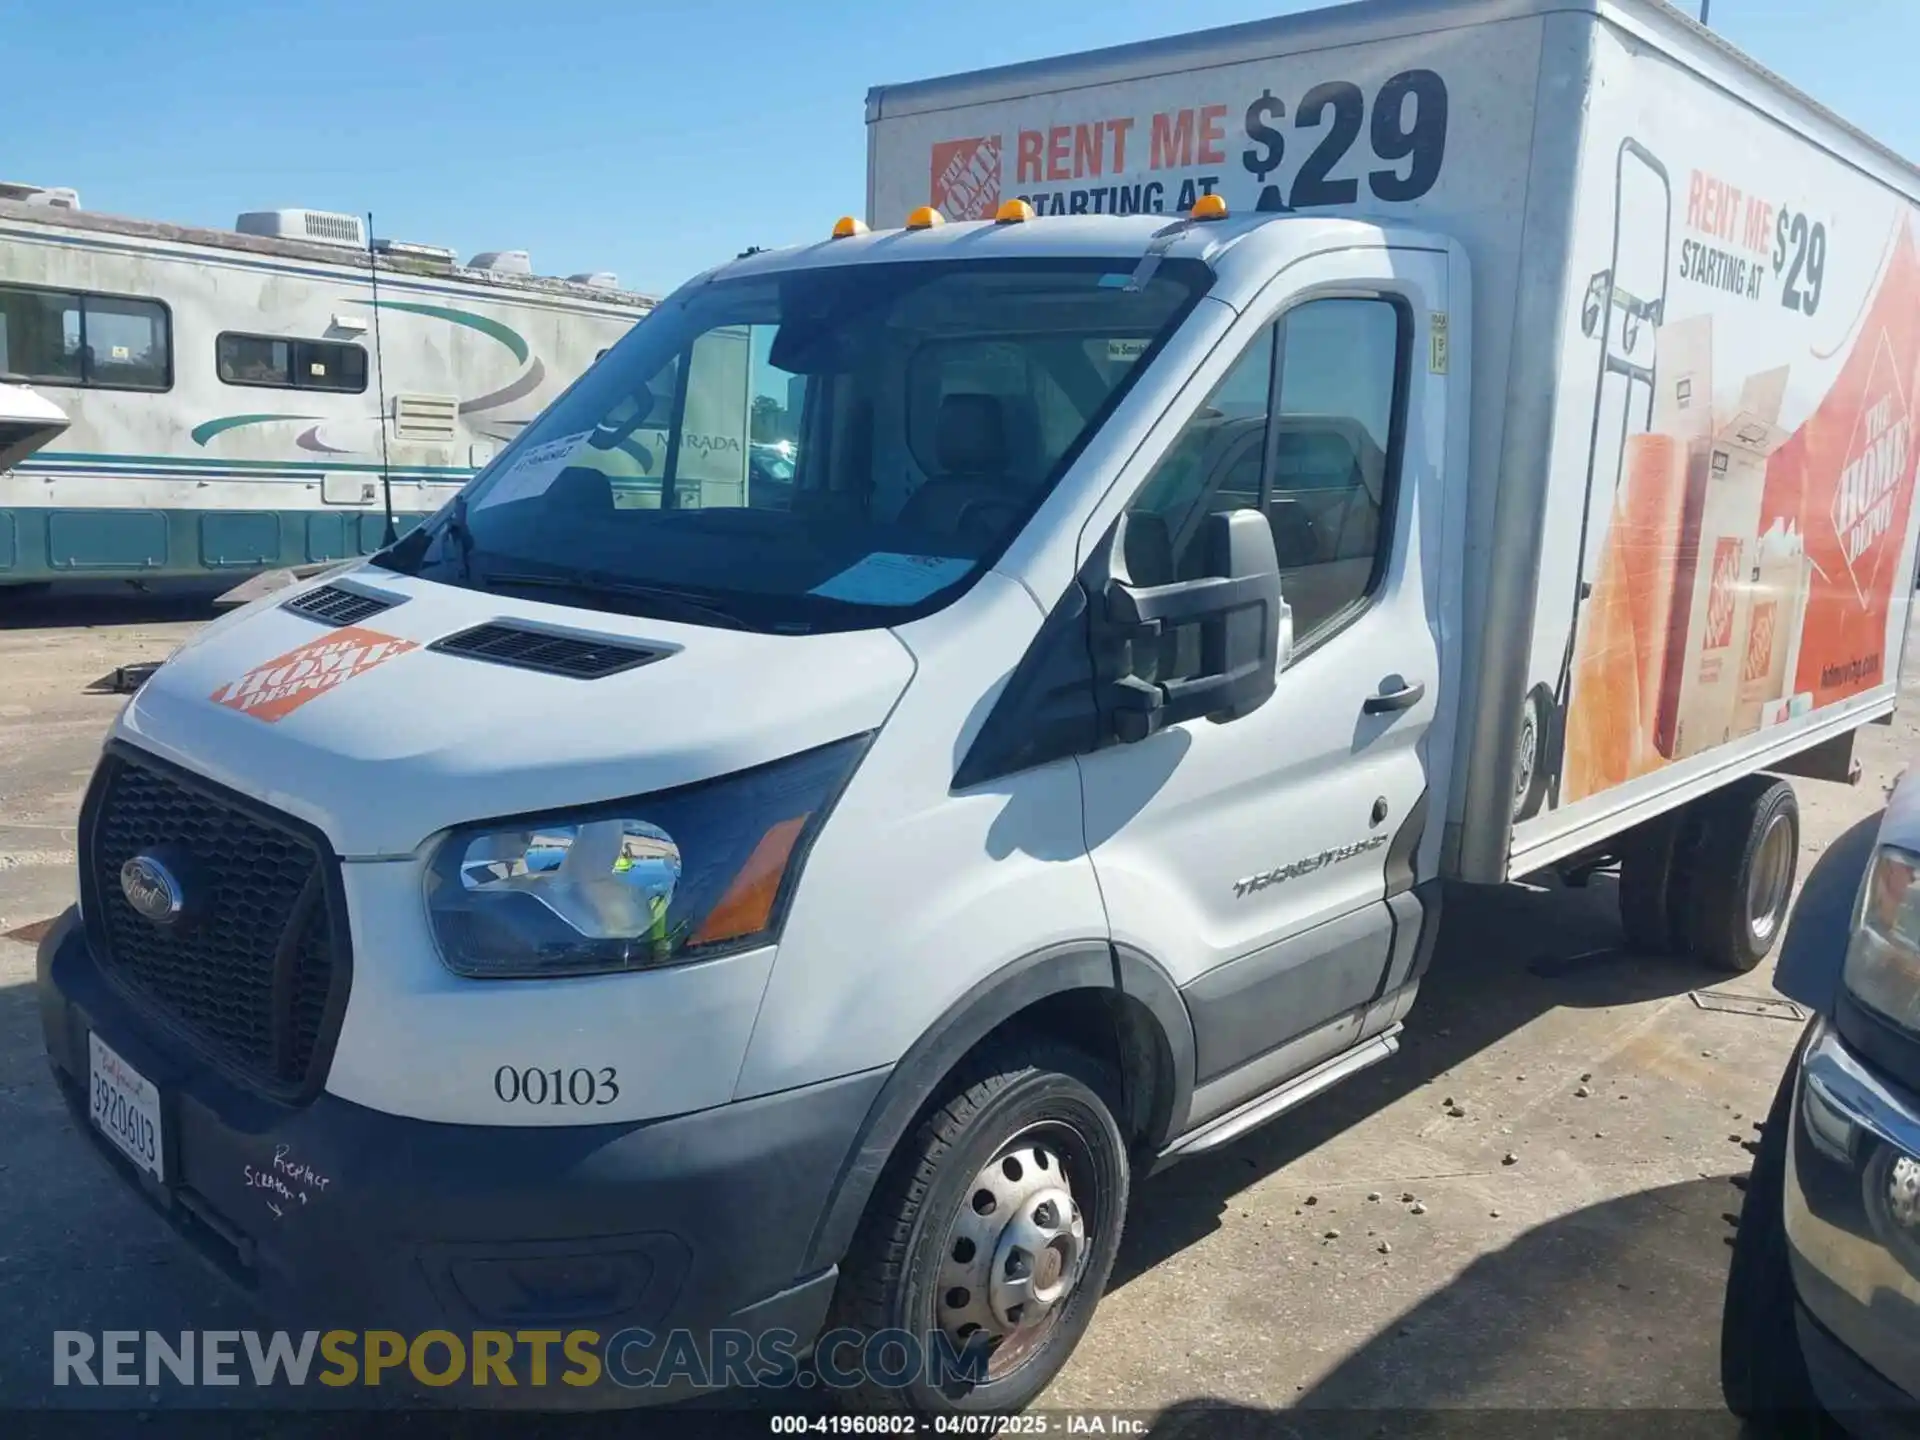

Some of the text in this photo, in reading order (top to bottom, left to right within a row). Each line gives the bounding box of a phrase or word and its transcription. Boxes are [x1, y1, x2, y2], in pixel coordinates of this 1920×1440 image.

[1017, 105, 1228, 184] RENT ME
[1242, 68, 1449, 208] $29
[1685, 168, 1773, 255] RENT ME
[1679, 238, 1764, 301] STARTING AT
[1772, 202, 1826, 317] $29
[494, 1065, 620, 1106] 00103
